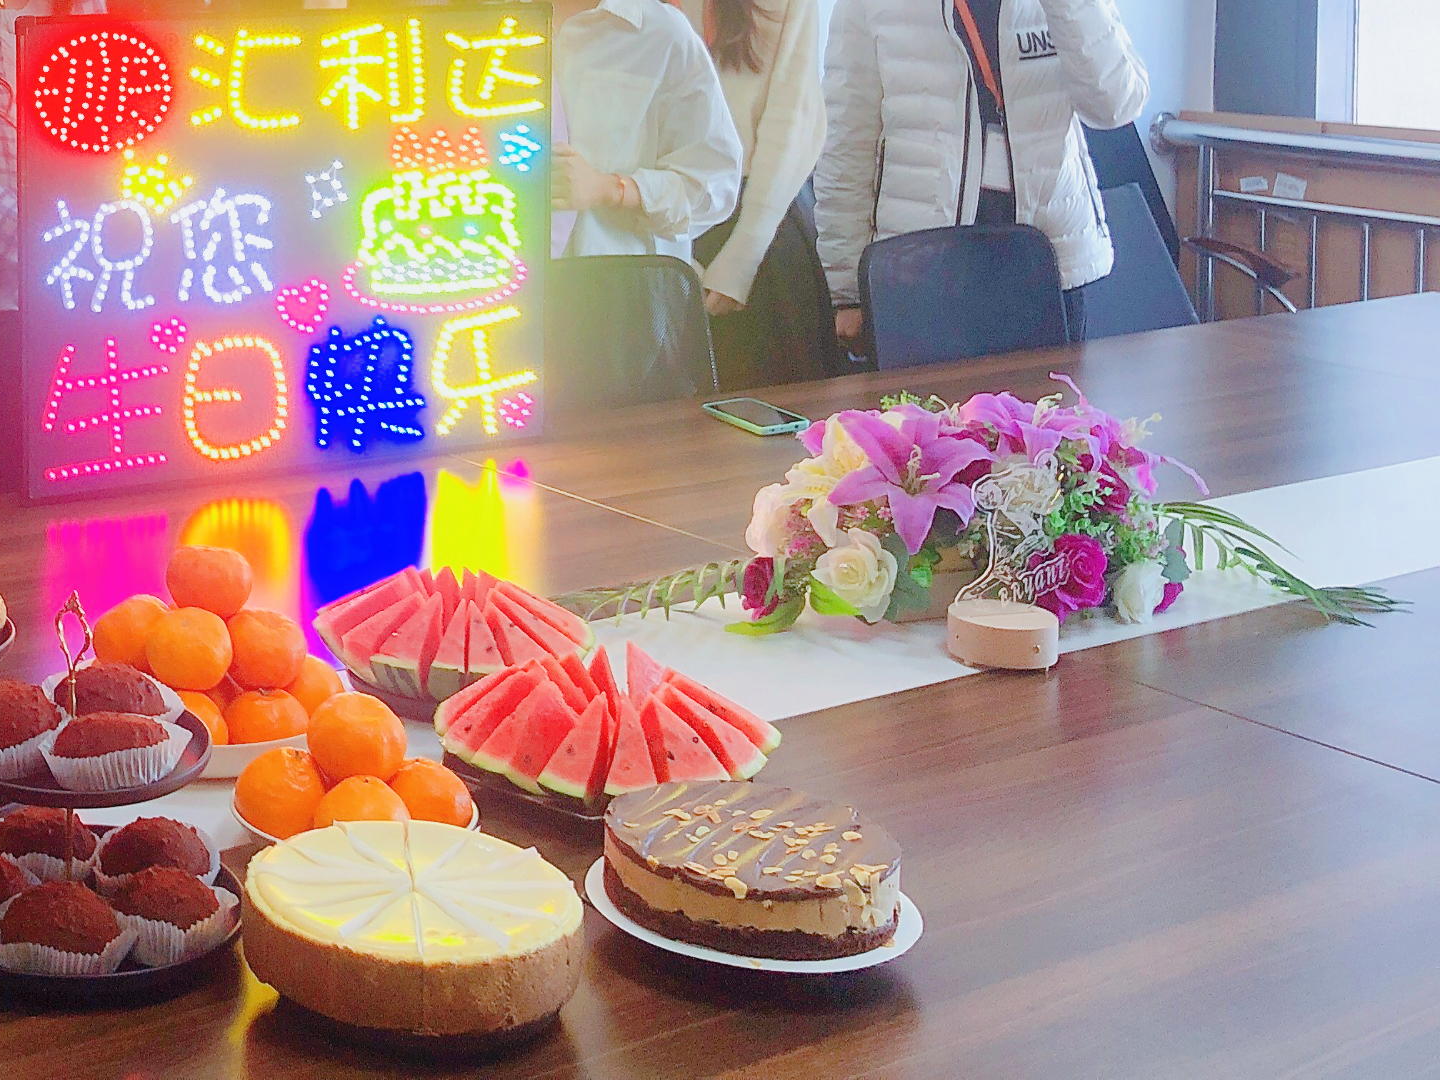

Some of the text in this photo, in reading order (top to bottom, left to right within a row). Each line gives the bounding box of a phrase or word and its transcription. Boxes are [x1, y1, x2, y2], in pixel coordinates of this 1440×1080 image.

[189, 16, 545, 131] 汇利达
[43, 188, 273, 312] 祝您
[42, 306, 538, 481] 生日快乐
